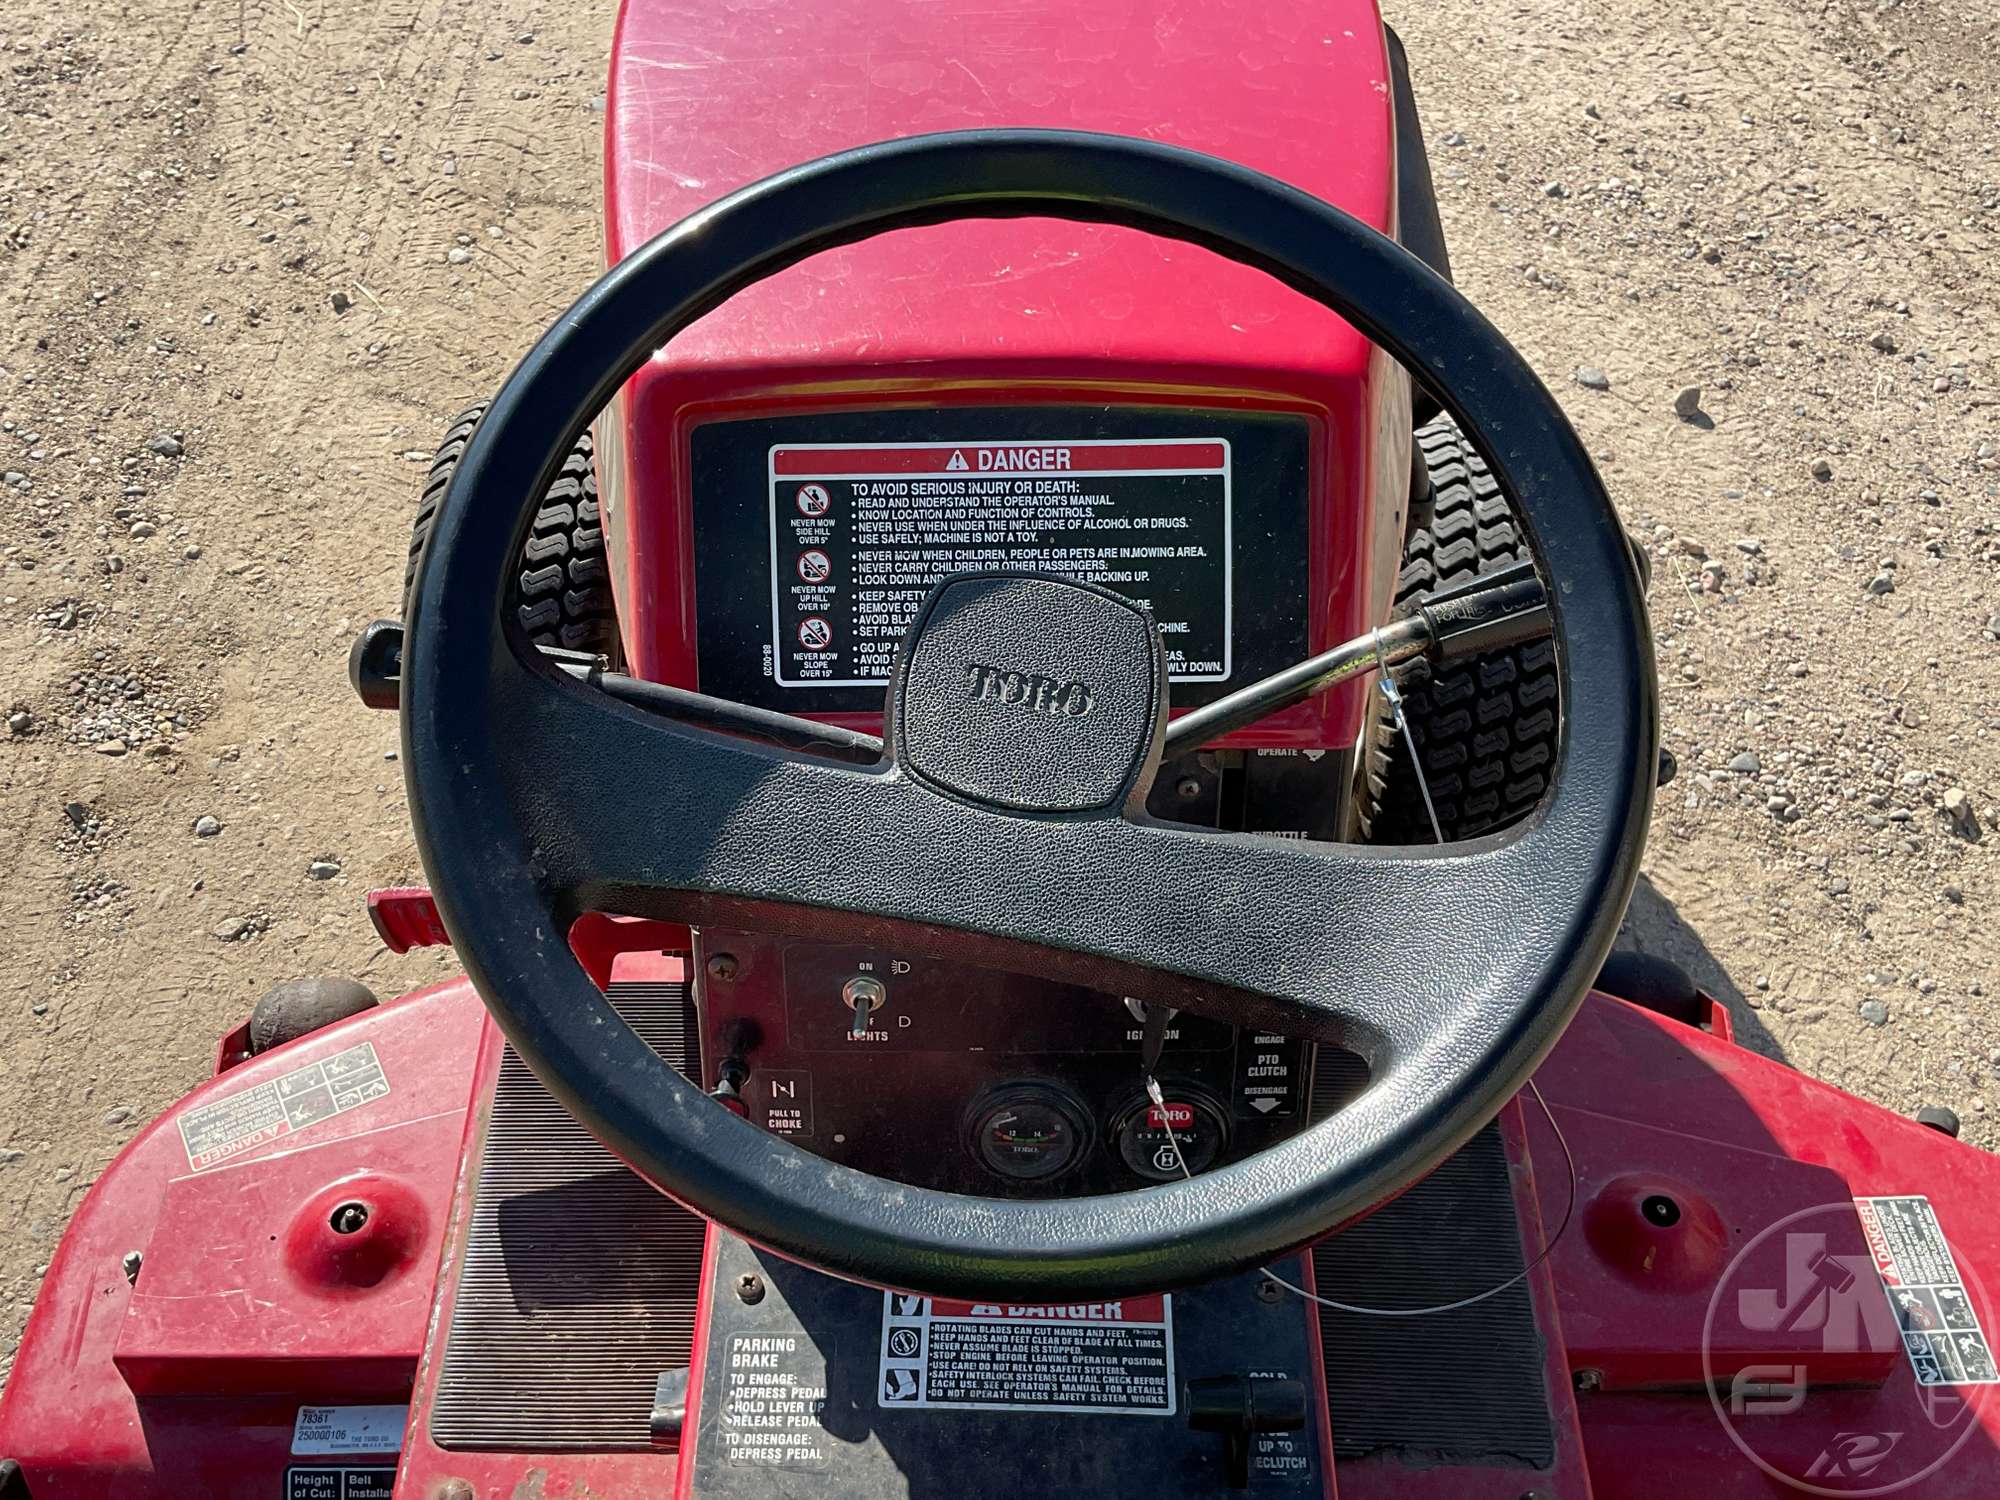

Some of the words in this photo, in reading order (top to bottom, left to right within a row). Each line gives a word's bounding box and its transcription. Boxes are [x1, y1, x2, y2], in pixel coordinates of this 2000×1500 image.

[978, 449, 1071, 470] DANGER
[852, 483, 868, 496] TO
[871, 483, 908, 496] AVOID
[911, 482, 965, 494] SERIOUS
[968, 482, 1012, 494] INJURY
[1014, 482, 1032, 494] OR
[1036, 481, 1080, 493] DEATH:
[858, 498, 890, 508] READ
[892, 498, 910, 508] AND
[912, 497, 980, 508] UNDERSTAND
[982, 496, 1002, 506] THE
[1004, 496, 1067, 506] OPERATOR'S
[1070, 495, 1114, 506] MANUAL.
[858, 510, 890, 520] KNOW
[892, 510, 942, 520] LOCATION
[944, 509, 966, 519] AND
[968, 508, 1018, 518] FUNCTION
[1021, 508, 1035, 518] OF
[1038, 507, 1095, 518] CONTROLS.
[858, 522, 892, 532] NEVER
[894, 522, 914, 532] USE
[918, 522, 948, 531] WHEN
[950, 521, 984, 530] UNDER
[987, 520, 1006, 530] THE
[1009, 520, 1065, 530] INFLUENCE
[1068, 520, 1082, 529] OF
[1084, 518, 1131, 529] ALCOHOL
[1134, 518, 1148, 528] OR
[1151, 518, 1189, 528] DRUGS.
[858, 534, 878, 544] USE
[881, 534, 922, 545] SAFELY;
[924, 532, 970, 543] MACHINE
[972, 532, 982, 542] IS
[984, 532, 1005, 542] NOT
[1006, 532, 1014, 542] A
[1016, 532, 1038, 542] TOY.
[858, 552, 892, 561] NEVER
[894, 552, 920, 561] MOW
[922, 551, 952, 560] WHEN
[954, 550, 1008, 561] CHILDREN,
[1010, 549, 1050, 560] PEOPLE
[1052, 549, 1067, 559] OR
[1070, 548, 1096, 558] PETS
[1097, 548, 1118, 558] ARE
[1132, 547, 1174, 558] MOWING
[1176, 547, 1207, 557] AREA.
[859, 563, 892, 572] NEVER
[894, 563, 928, 572] CARRY
[932, 562, 982, 572] CHILDREN
[984, 562, 1000, 570] OR
[1002, 561, 1036, 570] OTHER
[859, 575, 887, 584] LOOK
[890, 574, 920, 584] DOWN
[923, 574, 944, 584] AND
[1086, 572, 1132, 582] BACKING
[1134, 571, 1150, 581] UP.
[858, 591, 886, 601] KEEP
[888, 590, 926, 600] SAFETY
[859, 603, 901, 613] REMOVE
[859, 614, 890, 624] AVOID
[860, 626, 878, 636] SET
[860, 643, 875, 653] GO
[878, 643, 891, 652] UP
[762, 644, 772, 676] 88-0020
[804, 661, 828, 669] SLOPE
[860, 655, 890, 664] AVOID
[1190, 662, 1222, 672] DOWN.
[968, 663, 1094, 716] TORO
[1257, 748, 1298, 757] OPERATE
[859, 962, 873, 970] ON
[847, 1030, 888, 1041] LHTS
[1254, 1036, 1286, 1044] ENGAGE
[1258, 1054, 1279, 1064] PTO
[1248, 1066, 1288, 1076] CLUTCH
[1244, 1086, 1288, 1094] DISENGAGE
[769, 1110, 788, 1118] PULL
[790, 1110, 800, 1118] TO
[1150, 1110, 1190, 1120] TORO
[768, 1120, 802, 1128] CHOKE
[200, 1132, 264, 1165] DANGER
[1860, 1206, 1891, 1262] DANGER
[1008, 1302, 1122, 1320] DANGER
[934, 1324, 977, 1333] ROTATING
[979, 1326, 1012, 1334] BLADES
[1014, 1326, 1032, 1335] CAN
[1034, 1327, 1052, 1336] CUT
[1054, 1328, 1084, 1336] HANDS
[1086, 1329, 1104, 1337] AND
[1106, 1330, 1129, 1338] FEET.
[734, 1338, 796, 1352] PARKING
[934, 1334, 956, 1342] KEEP
[958, 1334, 988, 1342] HANDS
[990, 1335, 1008, 1343] AND
[1010, 1336, 1030, 1344] FEET
[1032, 1336, 1060, 1344] CLEAR
[1062, 1337, 1072, 1345] OF
[1074, 1338, 1102, 1346] BLADE
[1104, 1338, 1114, 1347] AT
[1116, 1339, 1134, 1348] ALL
[1135, 1340, 1164, 1348] TIMES.
[933, 1342, 960, 1351] NEVER
[962, 1343, 1000, 1352] ASSUME
[1002, 1344, 1028, 1352] BLADE
[1030, 1345, 1040, 1353] IS
[1042, 1346, 1083, 1354] STOPPED.
[732, 1354, 779, 1368] BRAKE
[932, 1361, 950, 1370] USE
[979, 1362, 990, 1370] DO
[992, 1363, 1010, 1372] NOT
[1012, 1364, 1033, 1372] RELY
[1035, 1364, 1048, 1372] ON
[1050, 1365, 1082, 1374] SAFETY
[1084, 1366, 1128, 1375] SYSTEMS.
[730, 1373, 744, 1385] TO
[749, 1373, 798, 1385] ENGAGE:
[736, 1388, 786, 1399] DEPRESS
[791, 1388, 827, 1399] PEDAL
[734, 1402, 764, 1413] HOLD
[769, 1402, 804, 1412] LEVER
[808, 1402, 825, 1412] UP
[302, 1414, 328, 1424] 78361
[732, 1416, 782, 1428] RELEASE
[788, 1416, 822, 1427] PEDAL
[726, 1434, 739, 1445] TO
[744, 1434, 812, 1445] DISENGAGE:
[1258, 1440, 1274, 1452] UP
[730, 1448, 782, 1460] DEPRESS
[786, 1448, 822, 1460] PEDAL
[1256, 1457, 1307, 1468] ECLUTCH
[294, 1475, 334, 1487] Height
[349, 1475, 372, 1484] Belt
[294, 1488, 306, 1498] of
[310, 1488, 336, 1498] Cut:
